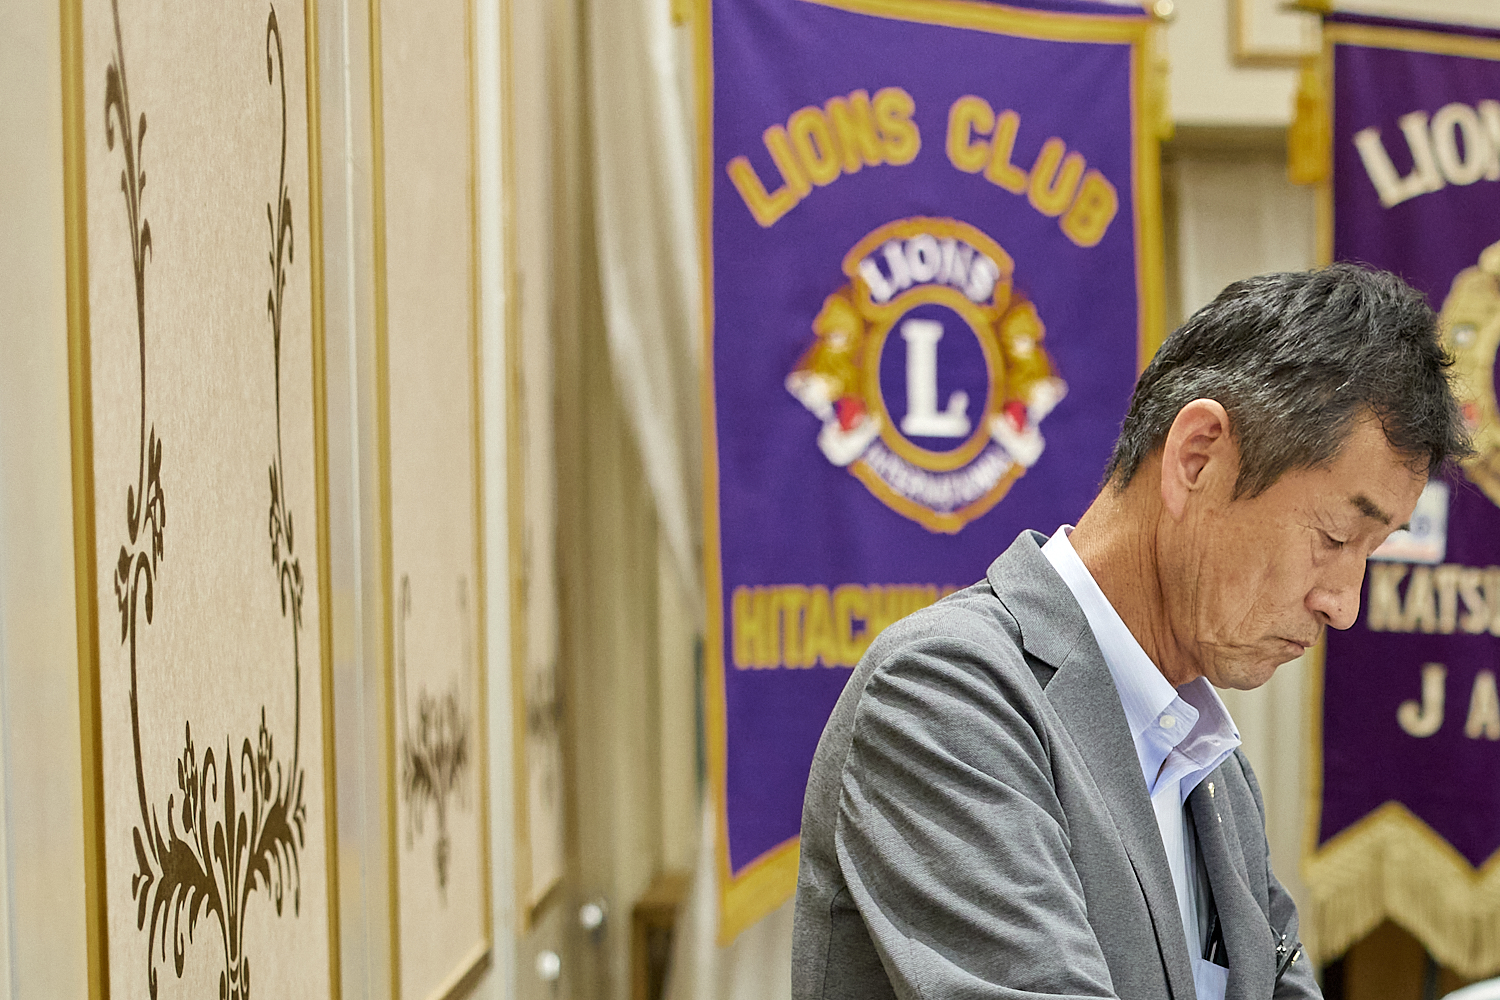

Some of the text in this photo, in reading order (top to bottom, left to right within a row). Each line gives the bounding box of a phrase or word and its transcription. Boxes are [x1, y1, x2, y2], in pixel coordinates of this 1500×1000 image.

[726, 86, 1119, 248] LIONS CLUB
[859, 233, 1000, 303] LIONS
[900, 320, 971, 438] L
